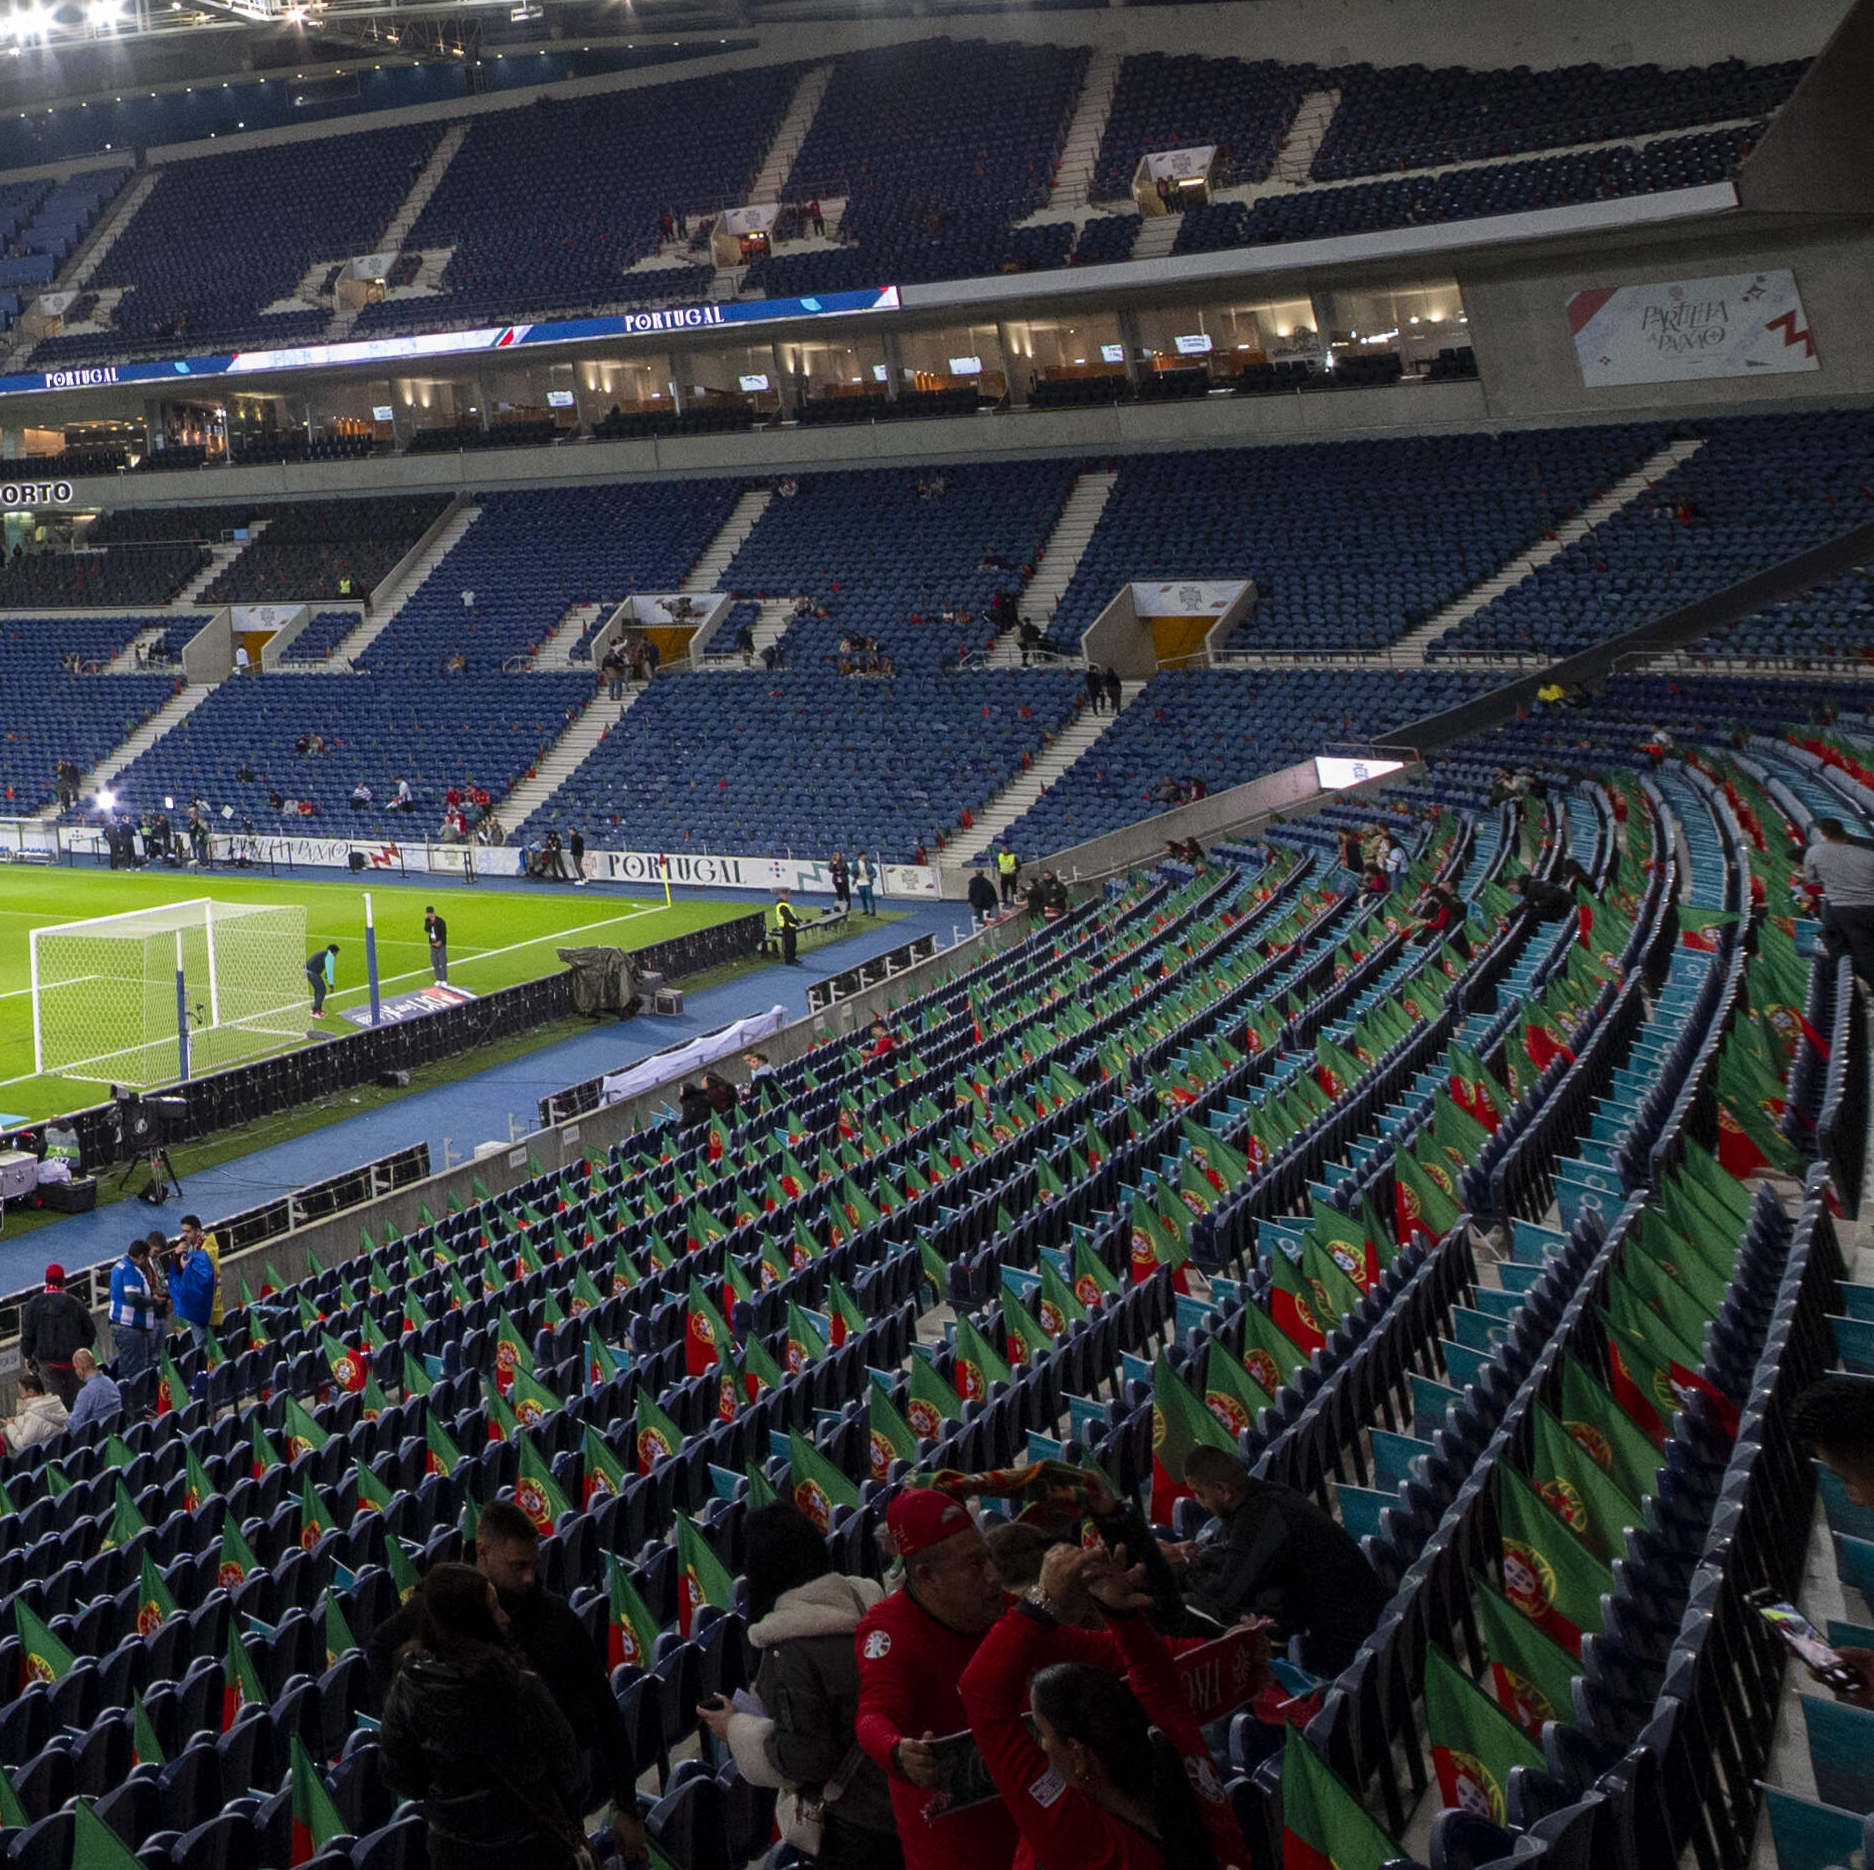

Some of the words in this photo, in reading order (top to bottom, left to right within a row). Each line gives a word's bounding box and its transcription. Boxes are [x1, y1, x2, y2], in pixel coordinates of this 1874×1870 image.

[624, 305, 725, 333] PORTUGAL
[45, 367, 120, 388] PORTUGAL
[608, 854, 747, 885] PORTUGAL
